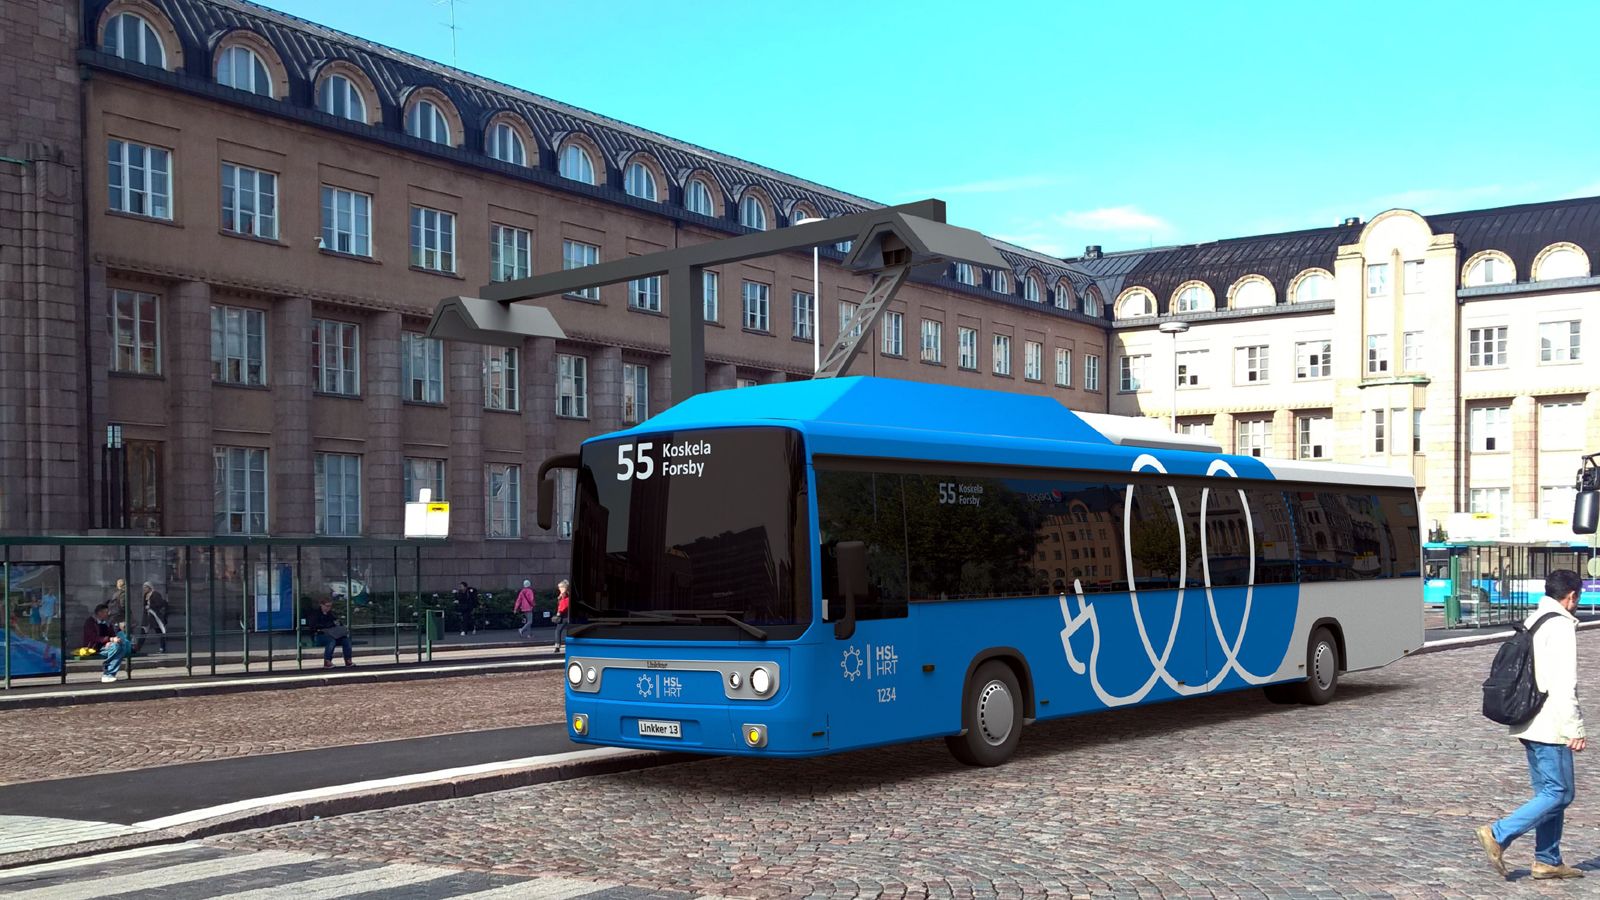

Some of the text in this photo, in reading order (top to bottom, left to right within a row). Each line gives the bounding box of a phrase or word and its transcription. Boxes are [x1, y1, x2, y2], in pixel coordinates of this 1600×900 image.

[663, 440, 712, 458] Koskela
[616, 442, 655, 481] 55
[662, 460, 705, 478] Forsby
[939, 482, 957, 505] 55
[959, 484, 984, 494] Koskela
[959, 495, 981, 507] Forsby
[876, 645, 898, 661] HSL
[876, 660, 898, 676] HRT
[663, 676, 682, 688] HSL
[663, 687, 682, 698] HRT
[877, 687, 897, 703] 1234
[640, 723, 679, 735] Linkker 13
